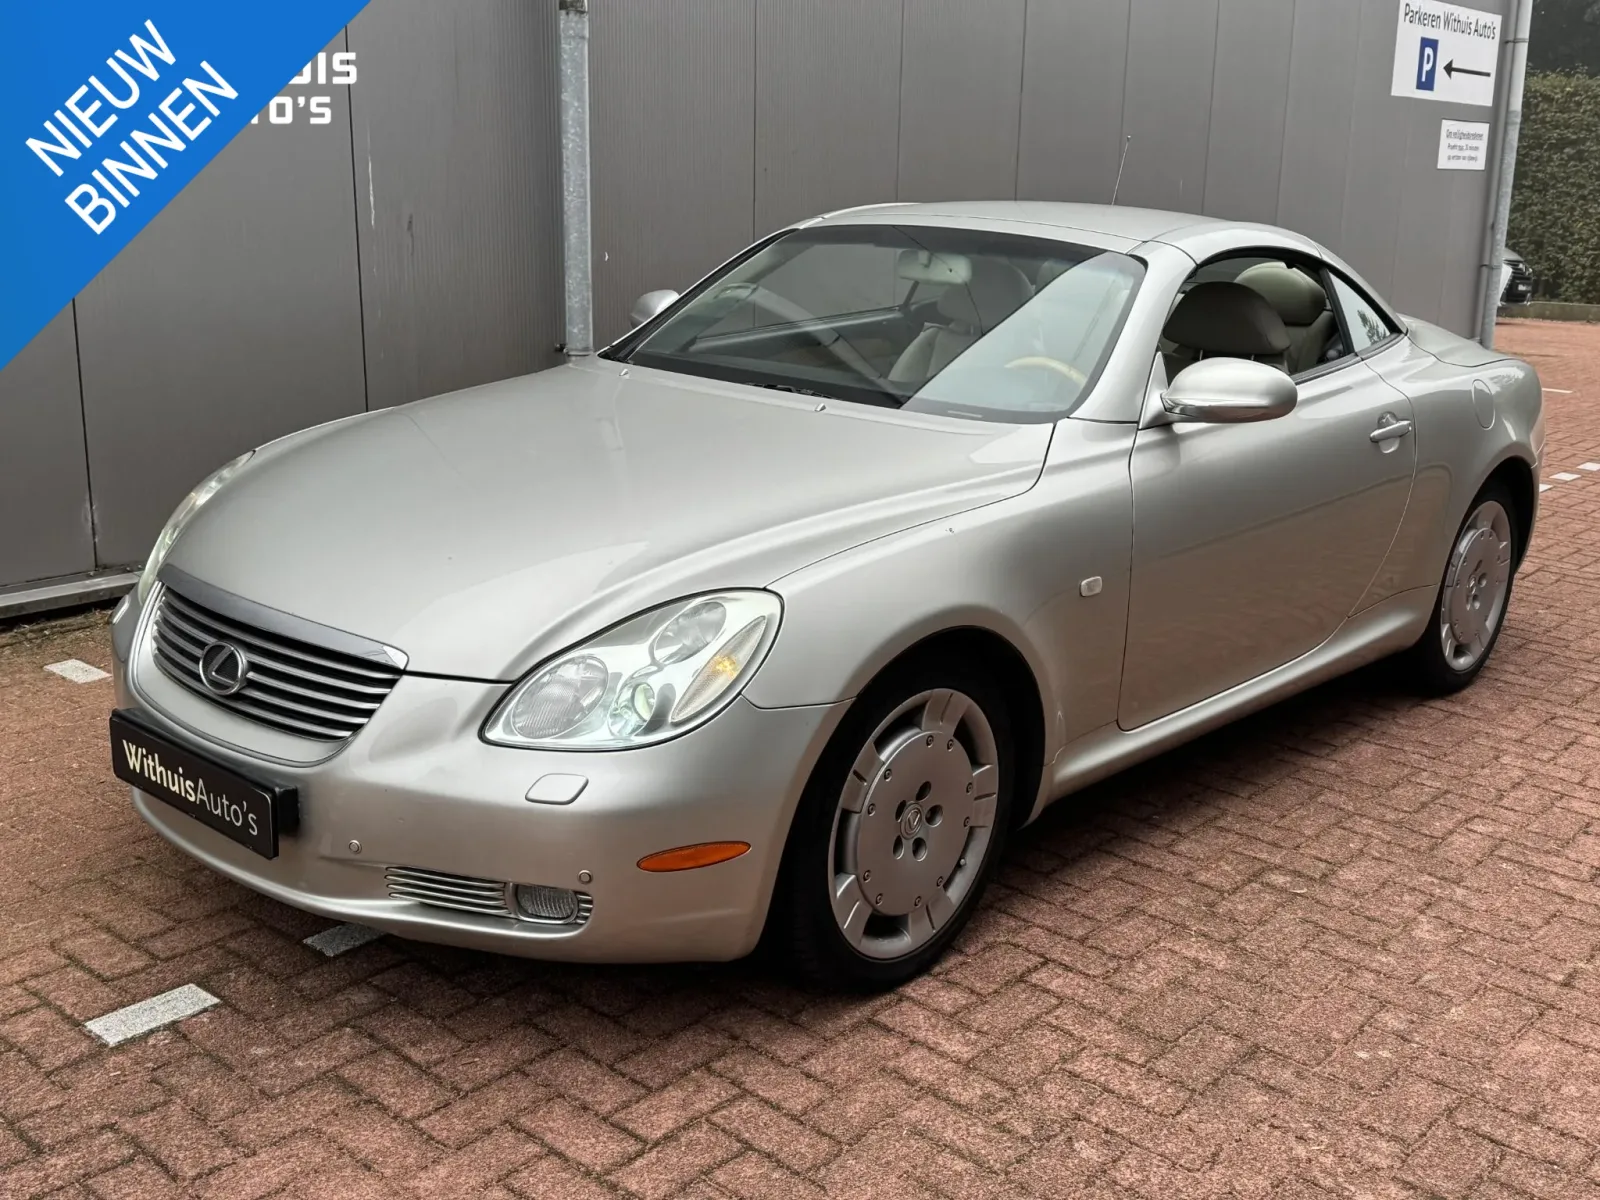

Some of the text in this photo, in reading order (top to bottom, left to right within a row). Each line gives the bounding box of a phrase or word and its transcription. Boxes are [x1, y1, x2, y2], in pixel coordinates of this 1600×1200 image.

[1403, 2, 1497, 40] Parkeren Withuis Auto's
[1421, 46, 1435, 82] P
[250, 95, 332, 125] O'S
